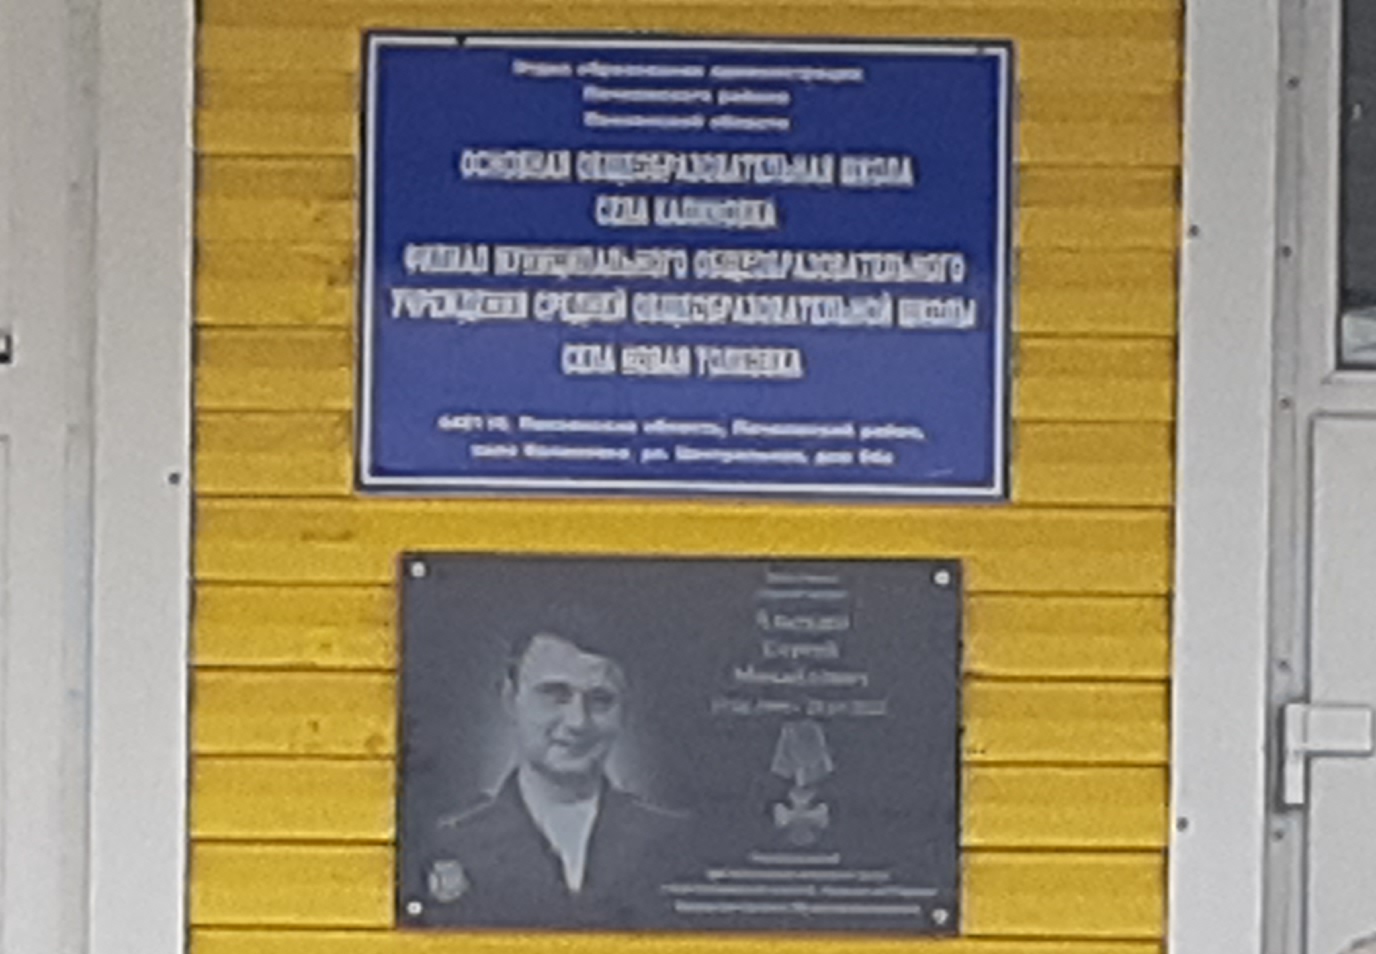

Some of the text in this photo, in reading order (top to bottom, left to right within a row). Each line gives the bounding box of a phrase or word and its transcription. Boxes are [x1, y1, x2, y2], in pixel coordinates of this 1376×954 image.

[460, 150, 913, 186] ОСНОВНАЯ ОБЩЕОБРАЗОВАТЕЛЬНАЯ ШКОЛА
[595, 195, 776, 229] СЕЛА КАЛИНОВКА
[404, 244, 965, 283] ФИЛИАЛ МУНИЦИПАЛЬНОГО ОБЩЕОБРАЗОВАТЕЛЬНОГО
[392, 288, 976, 328] УЧРЕЖДЕНИЯ СРЕДНЕЙ ОБЩЕОБРАЗОВАТЕЛЬНОЙ ШКОЛЫ
[562, 344, 616, 374] СЕЛА
[622, 345, 690, 376] НОВАЯ
